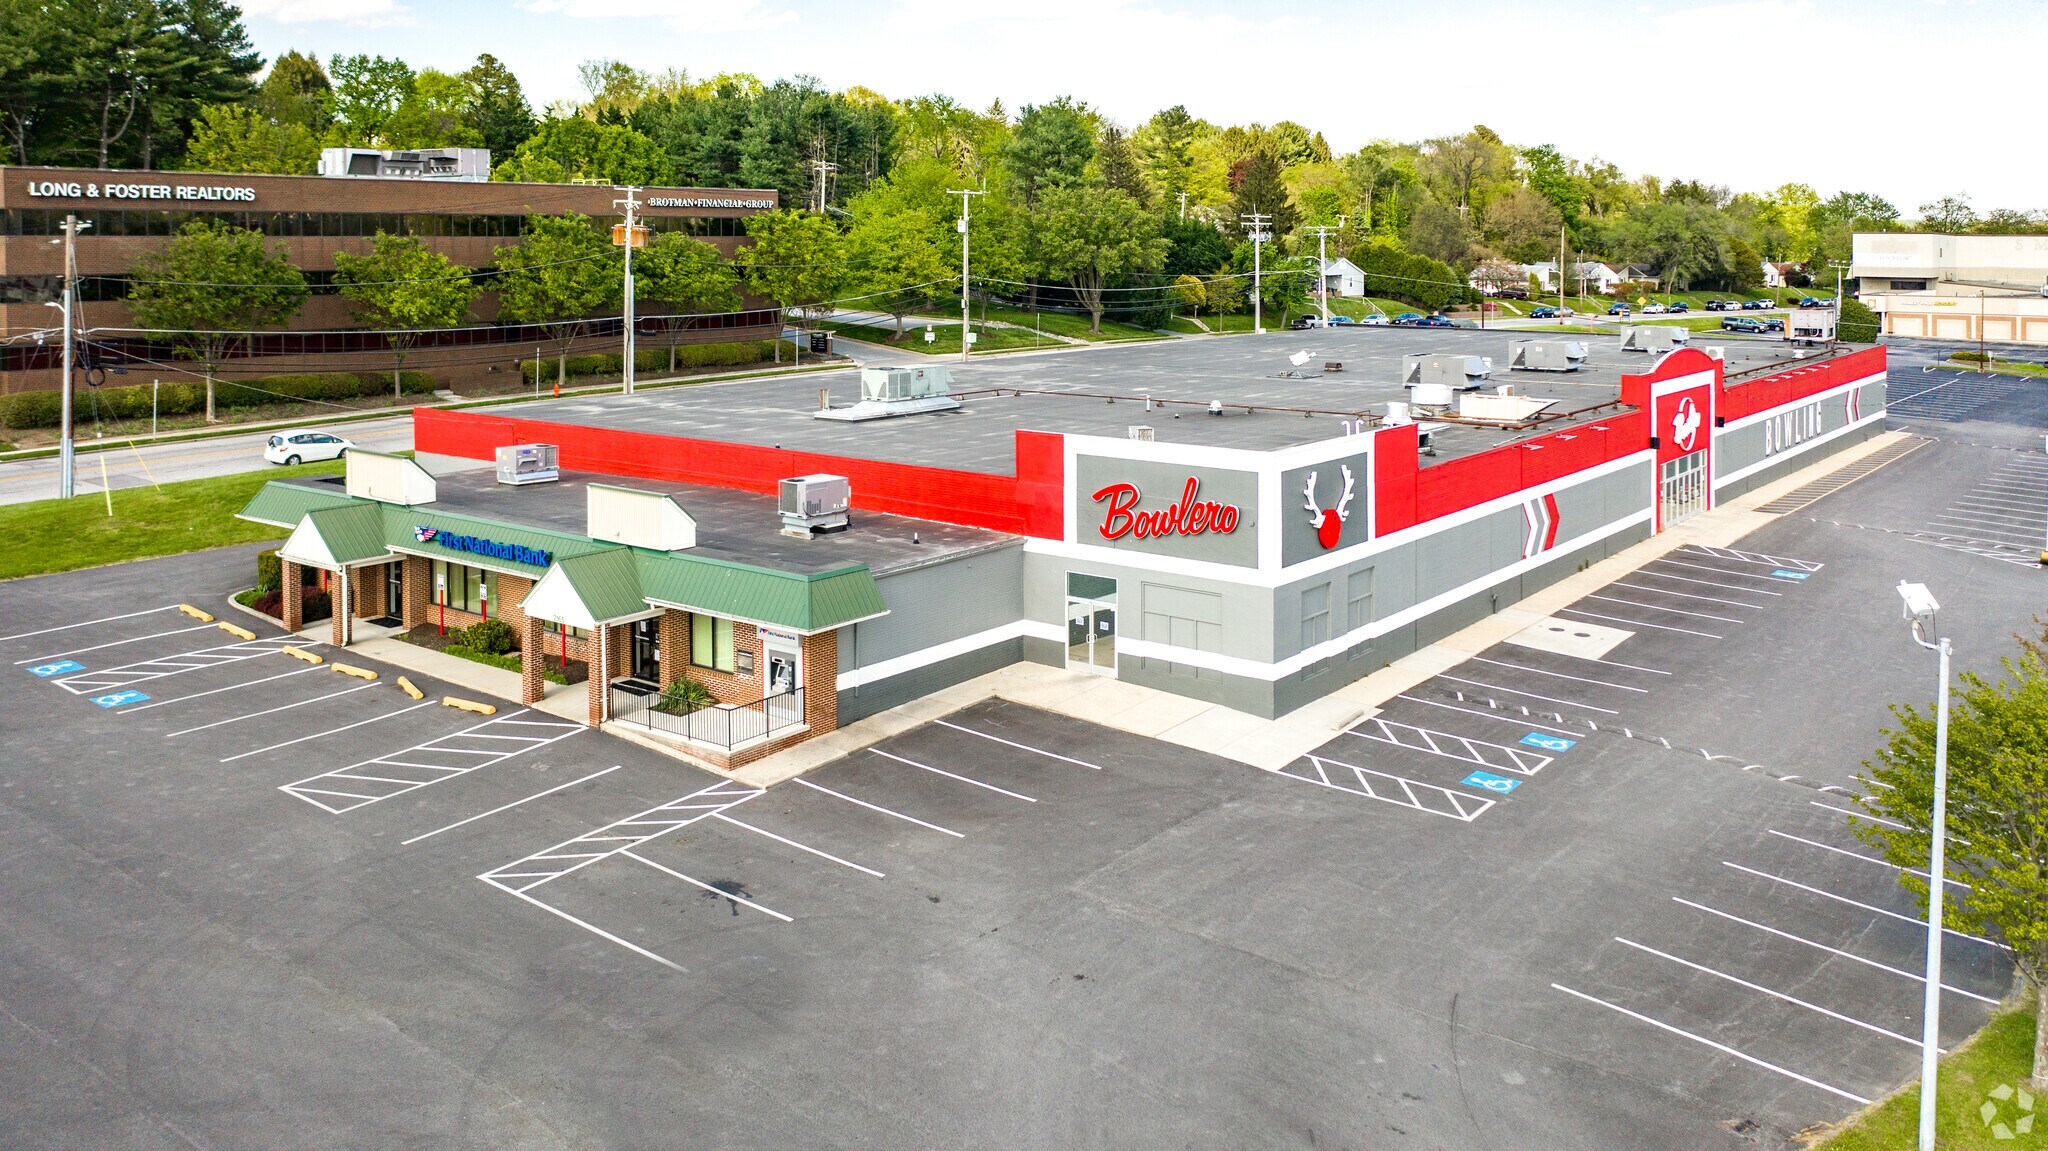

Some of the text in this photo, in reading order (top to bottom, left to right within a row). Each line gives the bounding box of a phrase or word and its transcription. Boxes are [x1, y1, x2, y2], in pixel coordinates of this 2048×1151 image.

[29, 182, 256, 201] LONG & FOSTER REALTORS
[1765, 401, 1822, 456] BOWLING
[1091, 475, 1240, 540] Bowlero
[439, 531, 550, 567] First National Bank
